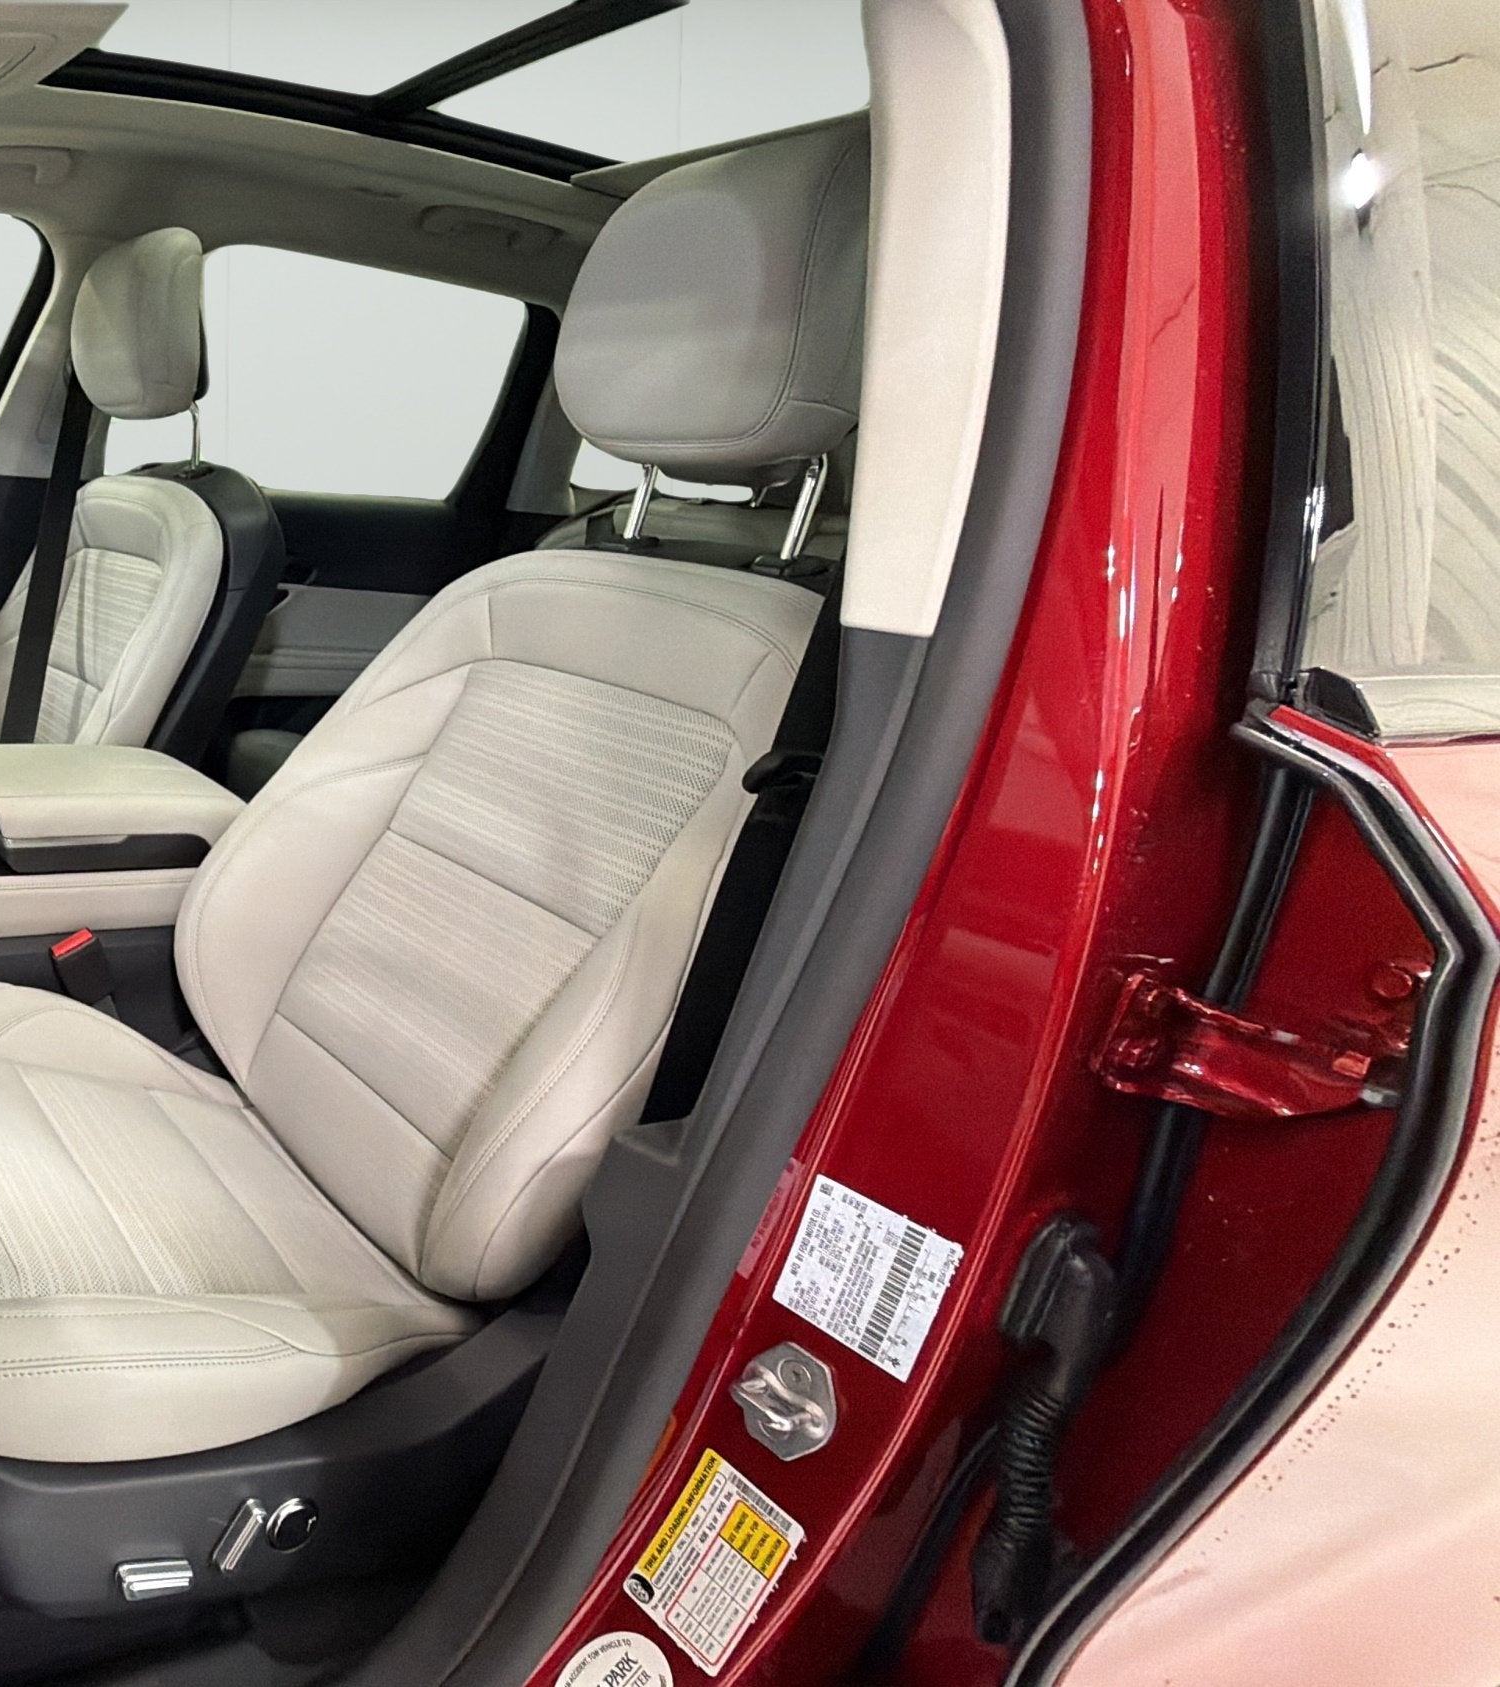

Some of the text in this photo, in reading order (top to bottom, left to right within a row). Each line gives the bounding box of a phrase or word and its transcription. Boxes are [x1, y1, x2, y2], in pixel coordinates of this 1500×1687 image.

[799, 1237, 811, 1254] FORD
[805, 1217, 818, 1239] MOTOR
[644, 1554, 659, 1572] TIRE
[656, 1538, 668, 1556] AND
[665, 1506, 689, 1540] LOADING
[686, 1456, 717, 1507] INFORMATION
[587, 1649, 601, 1662] TOW
[599, 1639, 622, 1654] VEHICLE
[621, 1638, 632, 1647] TO
[602, 1650, 639, 1687] PARK
